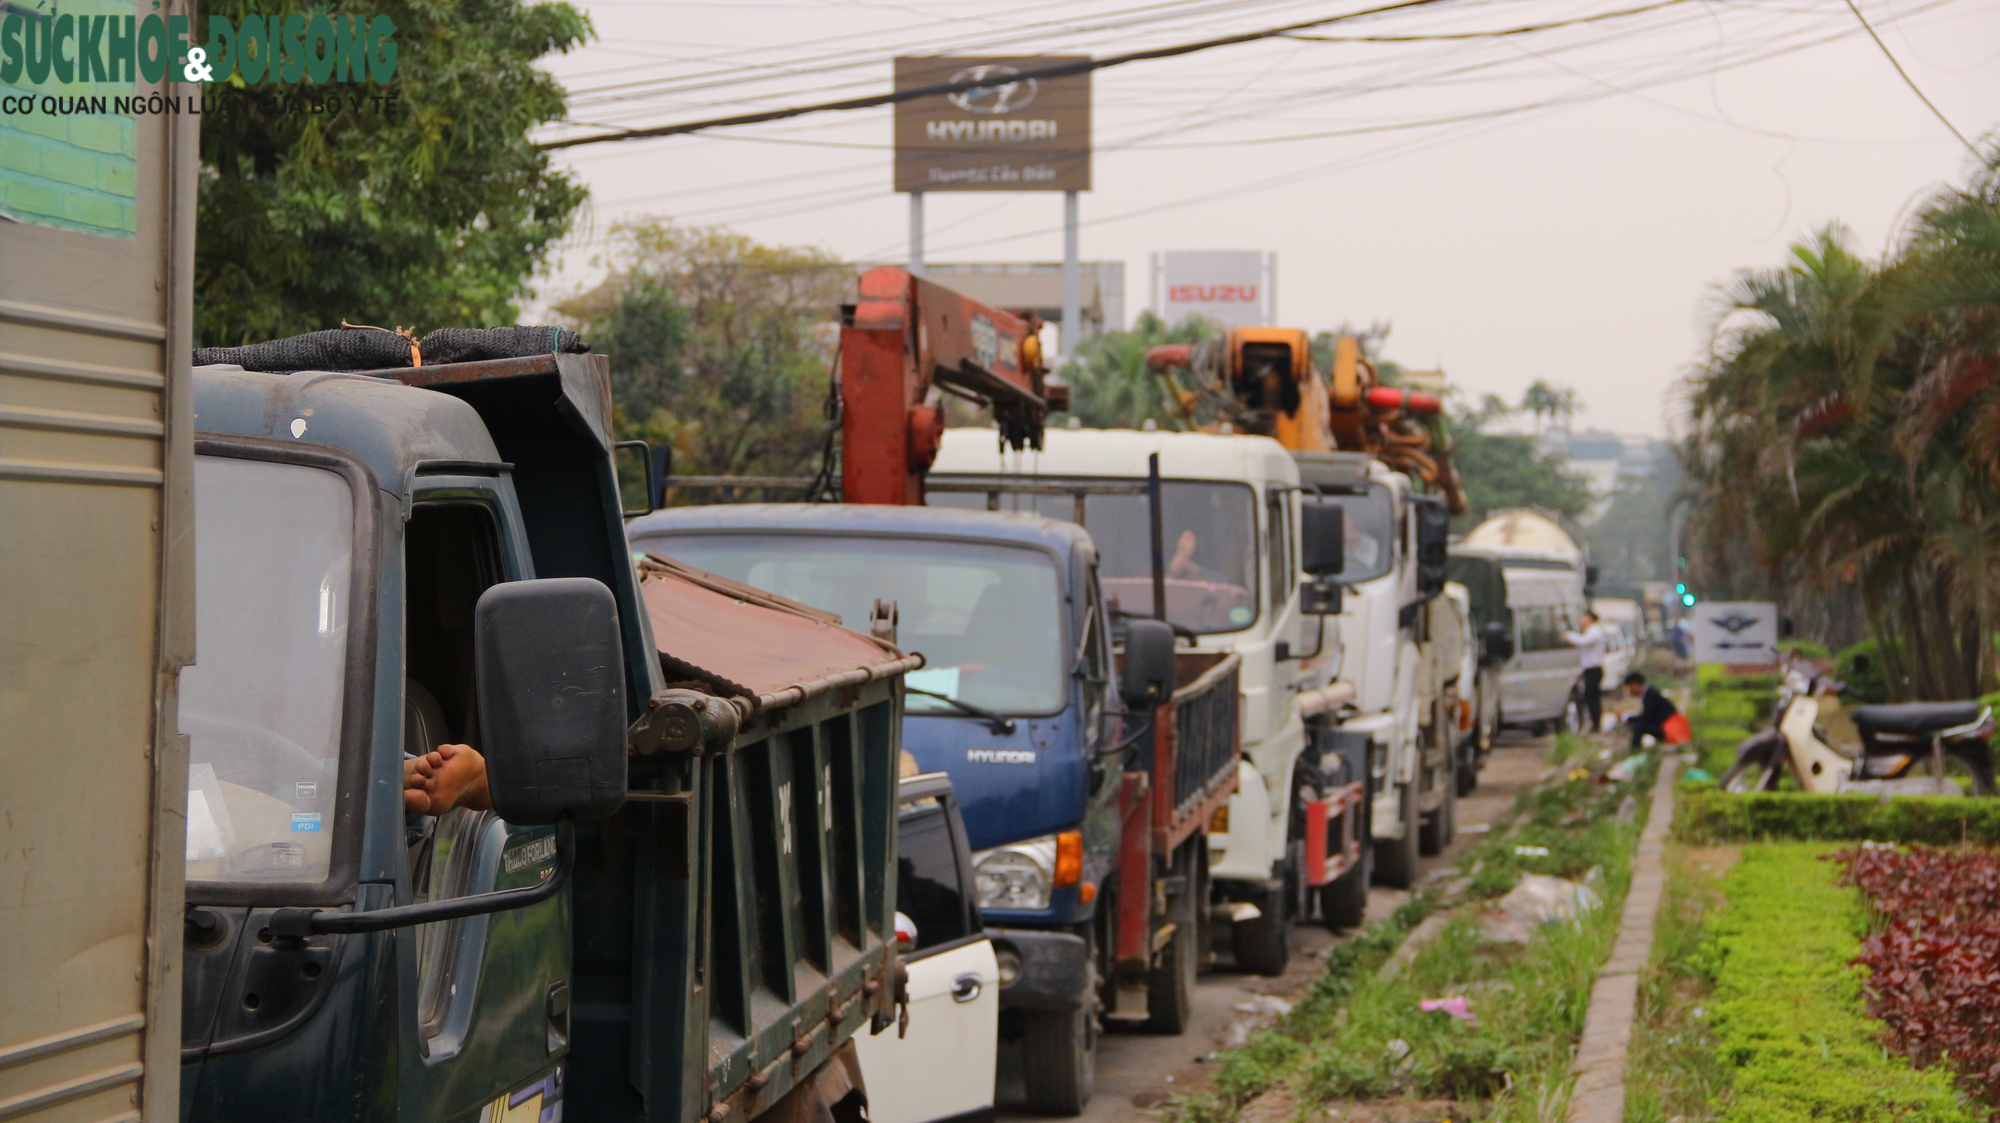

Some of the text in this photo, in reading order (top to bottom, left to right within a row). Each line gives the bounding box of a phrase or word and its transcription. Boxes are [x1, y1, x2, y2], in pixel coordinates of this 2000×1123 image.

[926, 120, 1058, 141] HYUNDAI
[1169, 284, 1257, 303] ISUZU
[967, 749, 1036, 764] HYUNDAI
